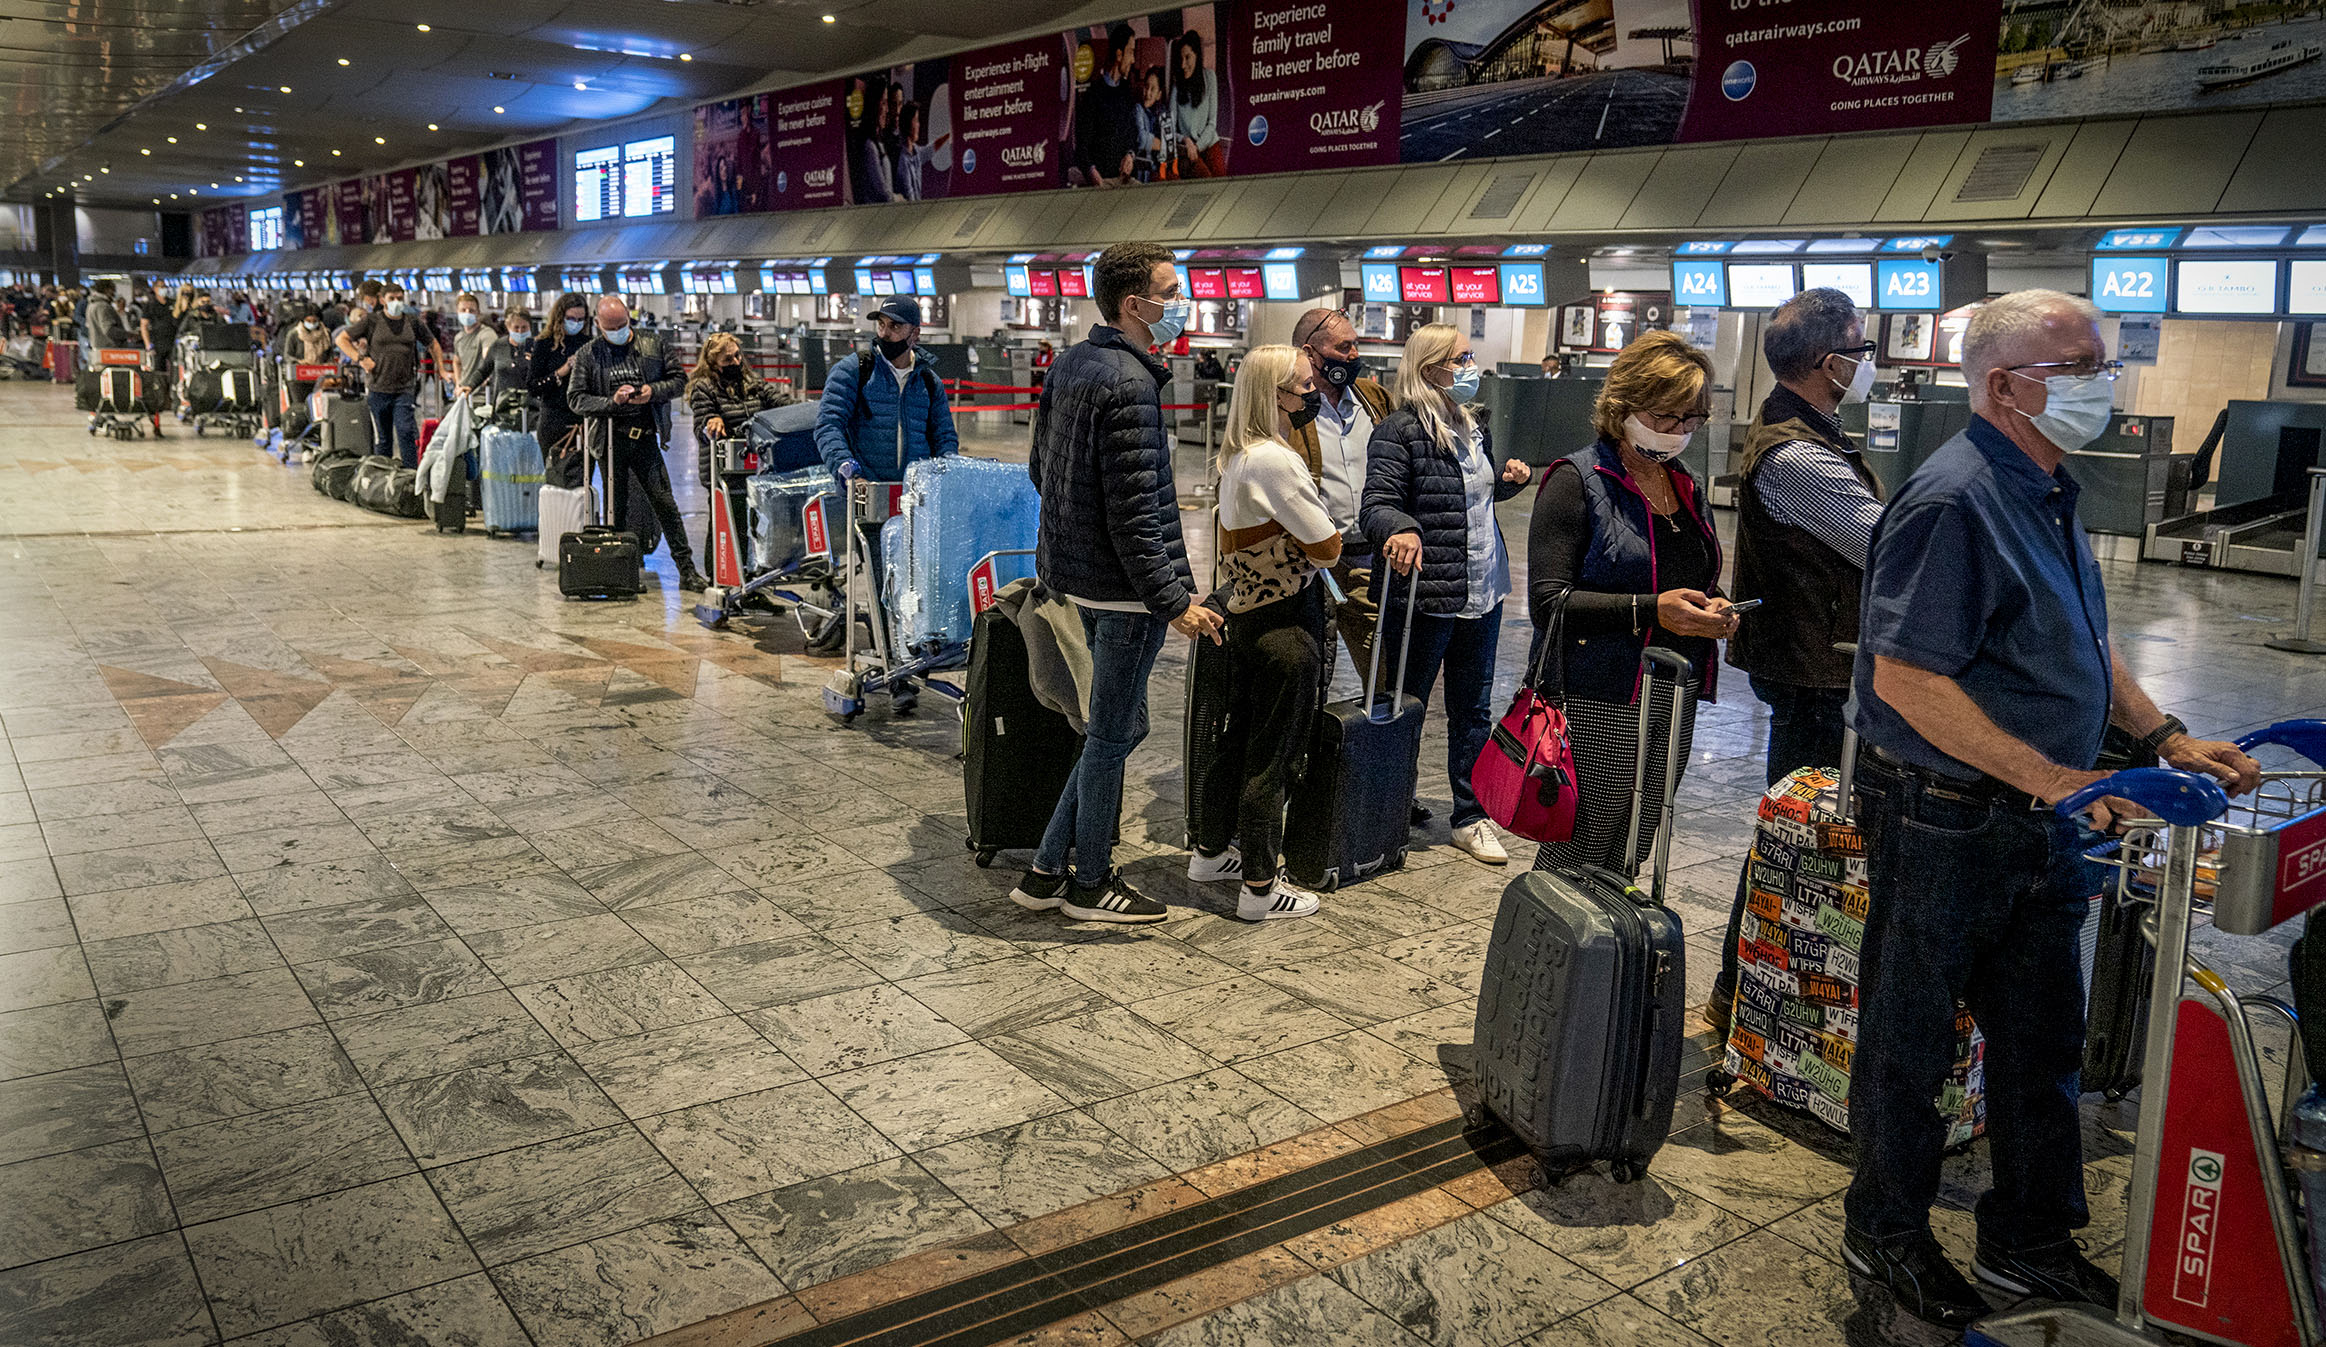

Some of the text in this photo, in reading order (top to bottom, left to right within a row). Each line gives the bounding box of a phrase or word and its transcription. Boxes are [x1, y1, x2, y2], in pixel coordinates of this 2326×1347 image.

[1254, 4, 1327, 31] Experience
[1252, 23, 1332, 55] family travel
[1726, 17, 1861, 48] qatarairways.com
[965, 61, 1011, 83] Experience
[1012, 51, 1049, 72] in-flight
[1251, 49, 1360, 80] like never before
[1833, 48, 1921, 82] QATAR
[964, 80, 1024, 101] entertainment
[1851, 75, 1889, 87] AIRWAYS
[1249, 86, 1326, 106] qatarairways.com
[1831, 92, 1955, 111] GOING PLACES TOGETHER
[778, 100, 810, 116] Experience
[963, 98, 1033, 121] like never before
[1310, 109, 1359, 133] QATAR
[1001, 145, 1033, 164] QATAR
[1328, 144, 1348, 153] PLACES
[1349, 142, 1378, 151] TOGETHER
[804, 170, 826, 186] QATAR
[1368, 273, 1394, 293] A26
[1406, 282, 1431, 291] at your
[1456, 282, 1483, 291] at your
[1509, 273, 1538, 294] A25
[1682, 272, 1718, 294] A24
[1887, 271, 1930, 296] A23
[2102, 271, 2154, 298] A22
[1406, 291, 1432, 299] service
[1457, 291, 1484, 299] service
[1761, 841, 1794, 871] G7RRL
[1801, 855, 1838, 876] G2UHW
[1761, 919, 1788, 946] W4YAI
[1823, 912, 1862, 945] W2UHG
[1743, 980, 1776, 1015] G7RRL
[1810, 980, 1841, 1000] W4YAI
[1738, 1003, 1767, 1030] W2UHQ
[1784, 1000, 1819, 1024] G2UHW
[1742, 1057, 1771, 1087] W4YAI
[1804, 1058, 1842, 1093] W2UHG
[2183, 1187, 2214, 1278] SPAR
